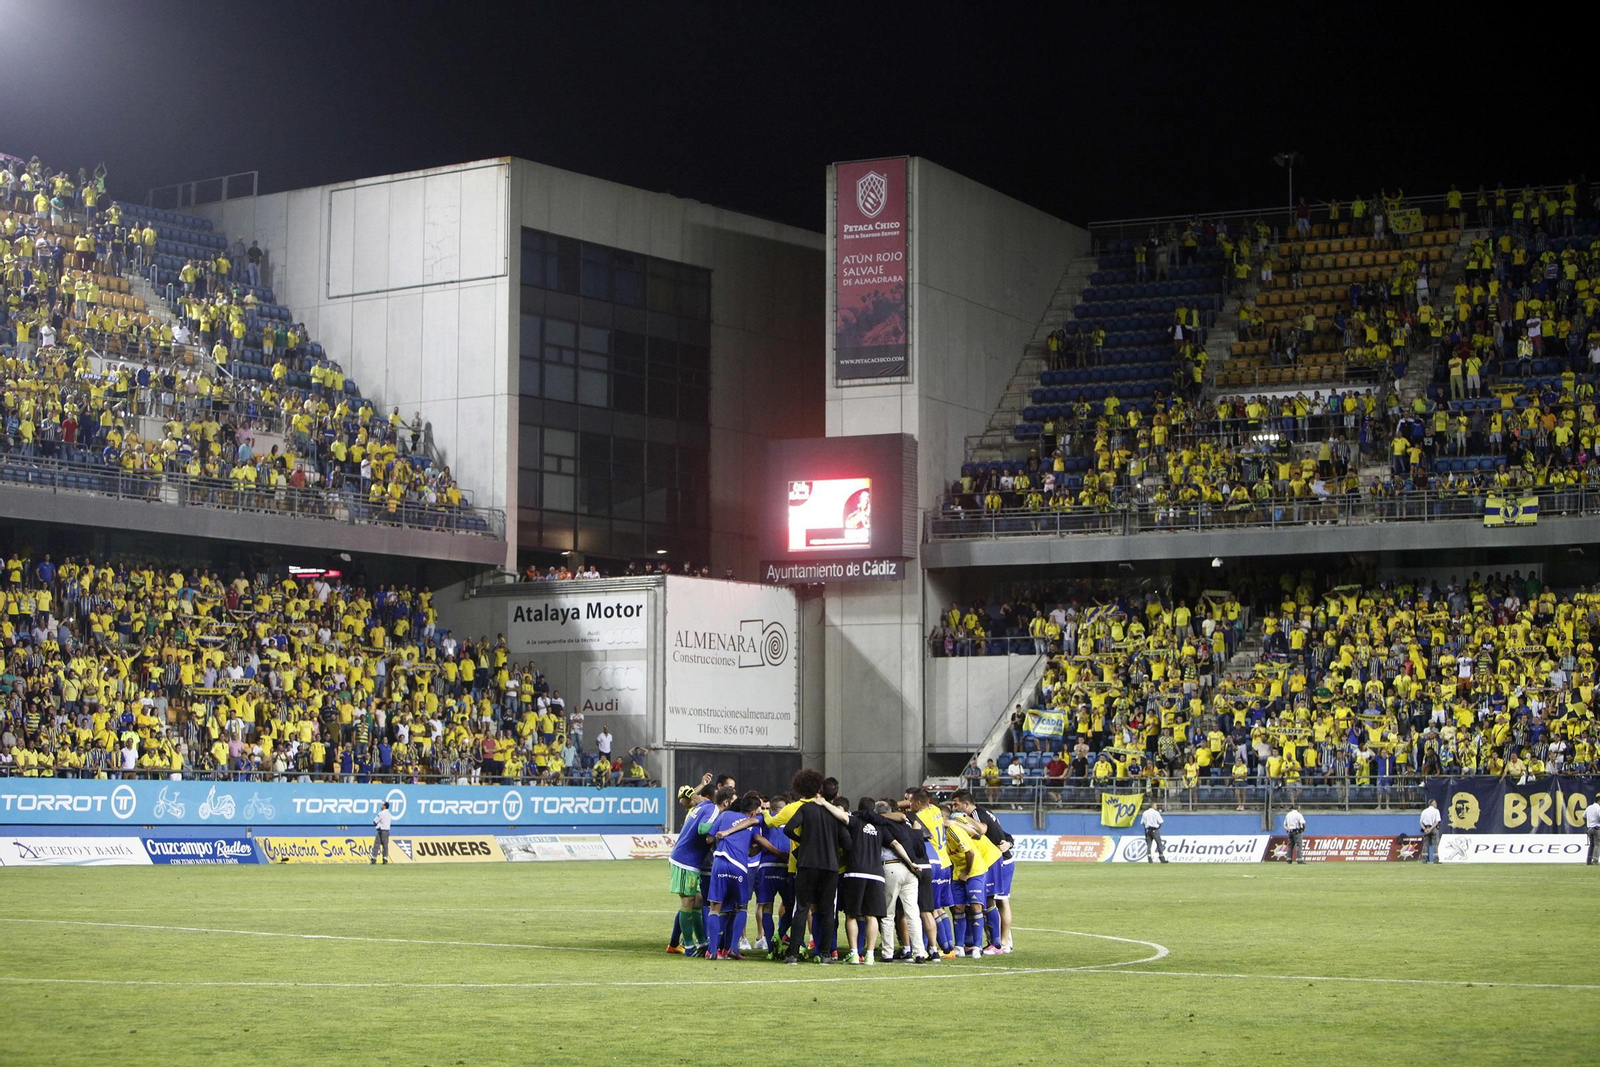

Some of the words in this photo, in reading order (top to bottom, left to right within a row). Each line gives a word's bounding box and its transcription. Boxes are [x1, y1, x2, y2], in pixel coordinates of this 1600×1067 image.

[843, 224, 874, 233] PETACA
[875, 221, 901, 230] CHICO
[842, 252, 873, 265] ATÚN
[876, 251, 903, 262] ROJO
[843, 264, 885, 277] SALVAJE
[843, 278, 853, 286] DE
[854, 275, 904, 286] ALMADRABA
[766, 563, 844, 583] Ayuntamiento
[846, 563, 860, 577] de
[862, 560, 897, 577] Cádiz
[513, 603, 580, 626] Atalaya
[586, 602, 643, 619] Motor
[674, 630, 757, 653] ALMENARA
[672, 651, 736, 667] Construcciones
[582, 699, 619, 712] Audi
[669, 706, 791, 721] www.construccionesalmenara.com
[697, 723, 722, 735] Tlfno:
[723, 724, 738, 735] 856
[738, 725, 754, 735] 074
[755, 725, 769, 736] 901
[1, 794, 107, 812] TORROT
[293, 797, 381, 814] TORROT
[417, 799, 500, 815] TORROT
[530, 796, 659, 815] TORROT.COM
[1503, 790, 1600, 829] BRIG
[33, 845, 83, 856] PUERTO
[94, 843, 133, 855] BAHÍA
[146, 839, 213, 857] Cruzcampo
[214, 840, 252, 858] Radler
[320, 839, 346, 857] San
[416, 841, 491, 857] JUNKERS
[1313, 838, 1341, 850] TIMÓN
[1345, 839, 1359, 850] DE
[1360, 839, 1393, 850] ROCHE
